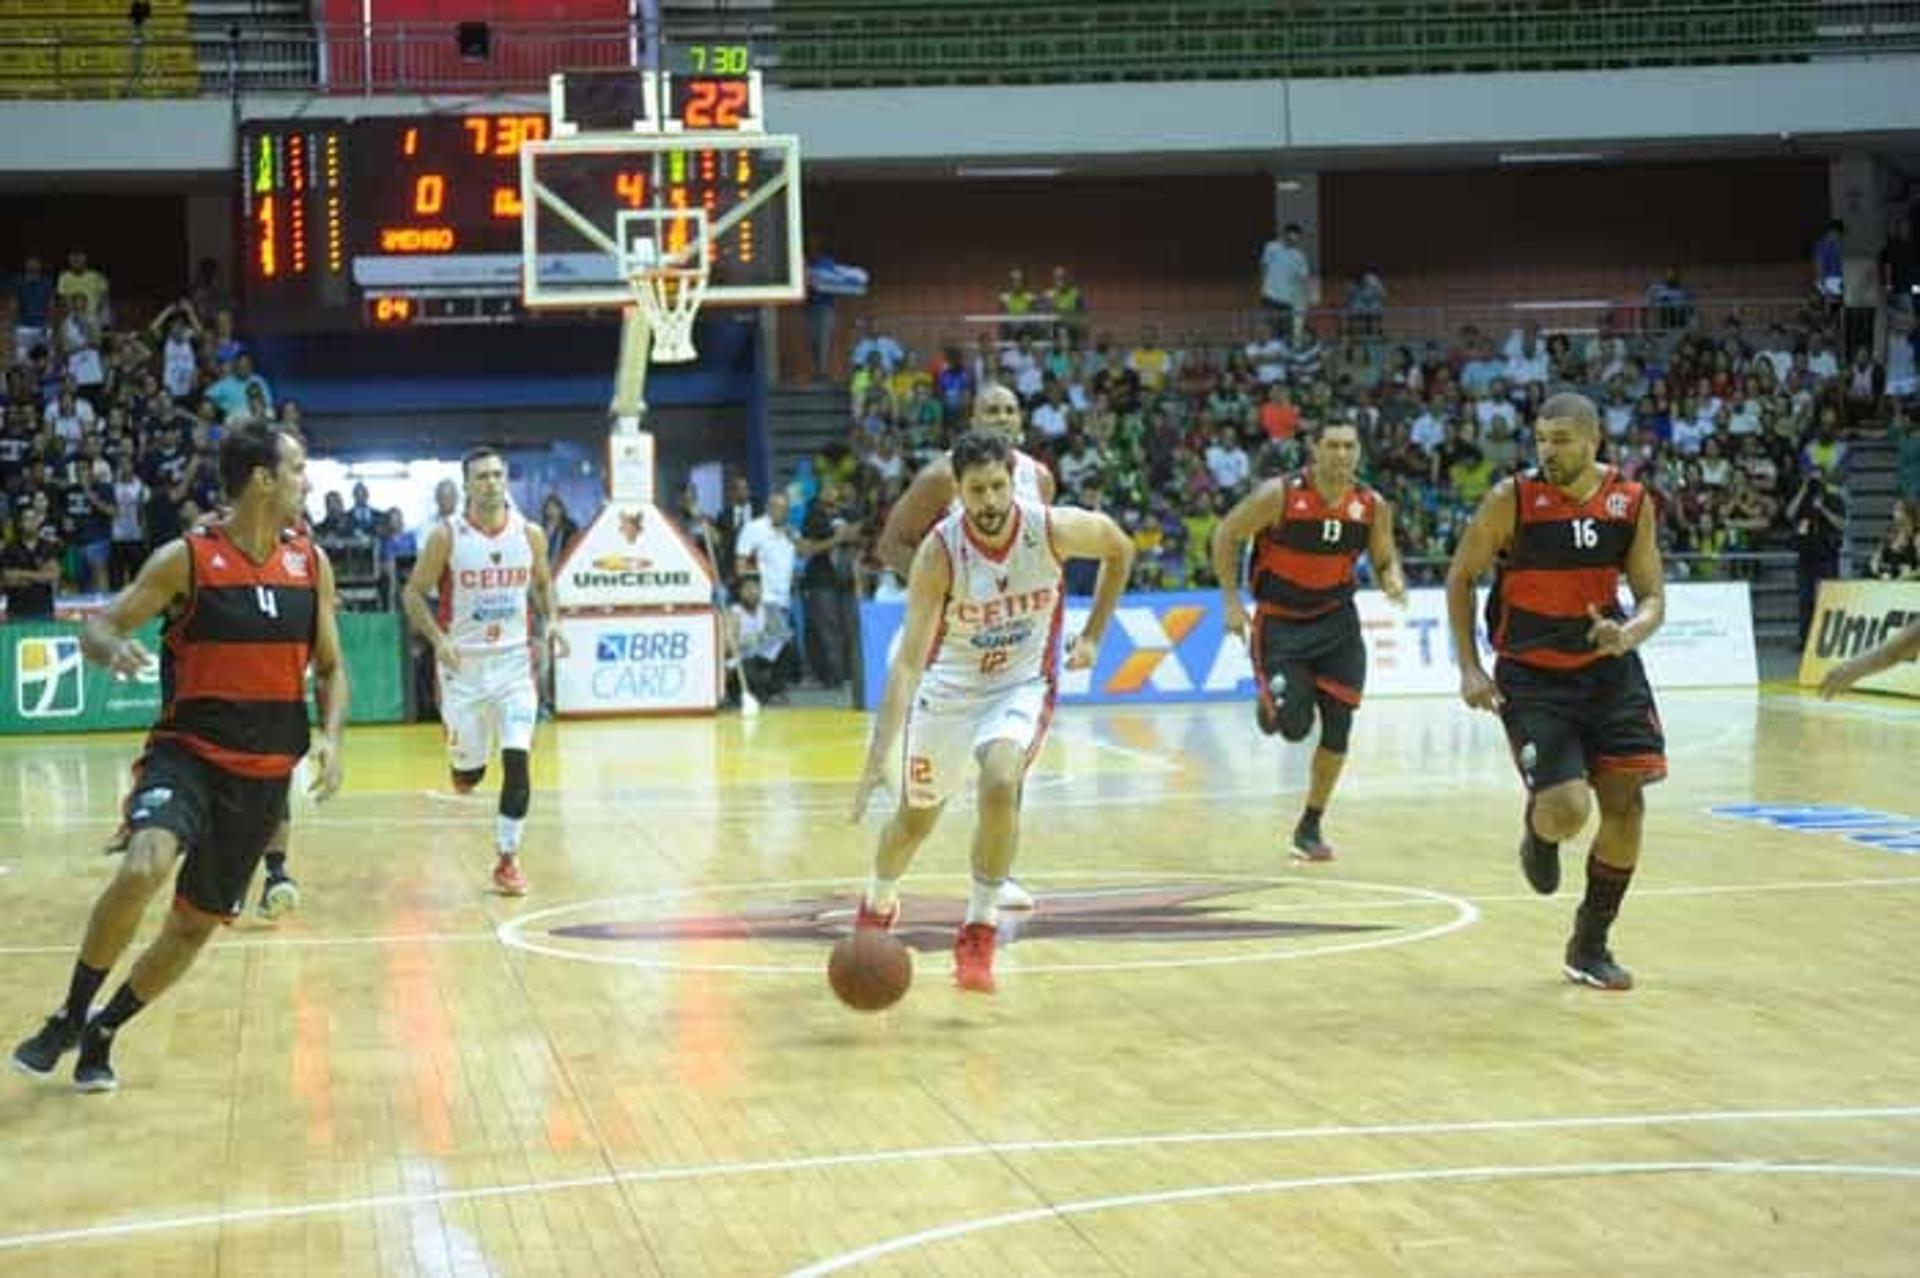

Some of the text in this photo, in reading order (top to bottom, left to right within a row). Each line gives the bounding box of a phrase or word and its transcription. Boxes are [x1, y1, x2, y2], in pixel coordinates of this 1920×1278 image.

[685, 80, 747, 128] 22
[405, 129, 418, 154] 1
[415, 174, 443, 214] 0
[616, 172, 645, 209] 4
[1323, 518, 1341, 542] 13
[1572, 518, 1598, 549] 16
[256, 586, 278, 617] 4
[631, 632, 689, 662] BRB
[980, 650, 1007, 675] 12
[592, 664, 686, 700] CARD
